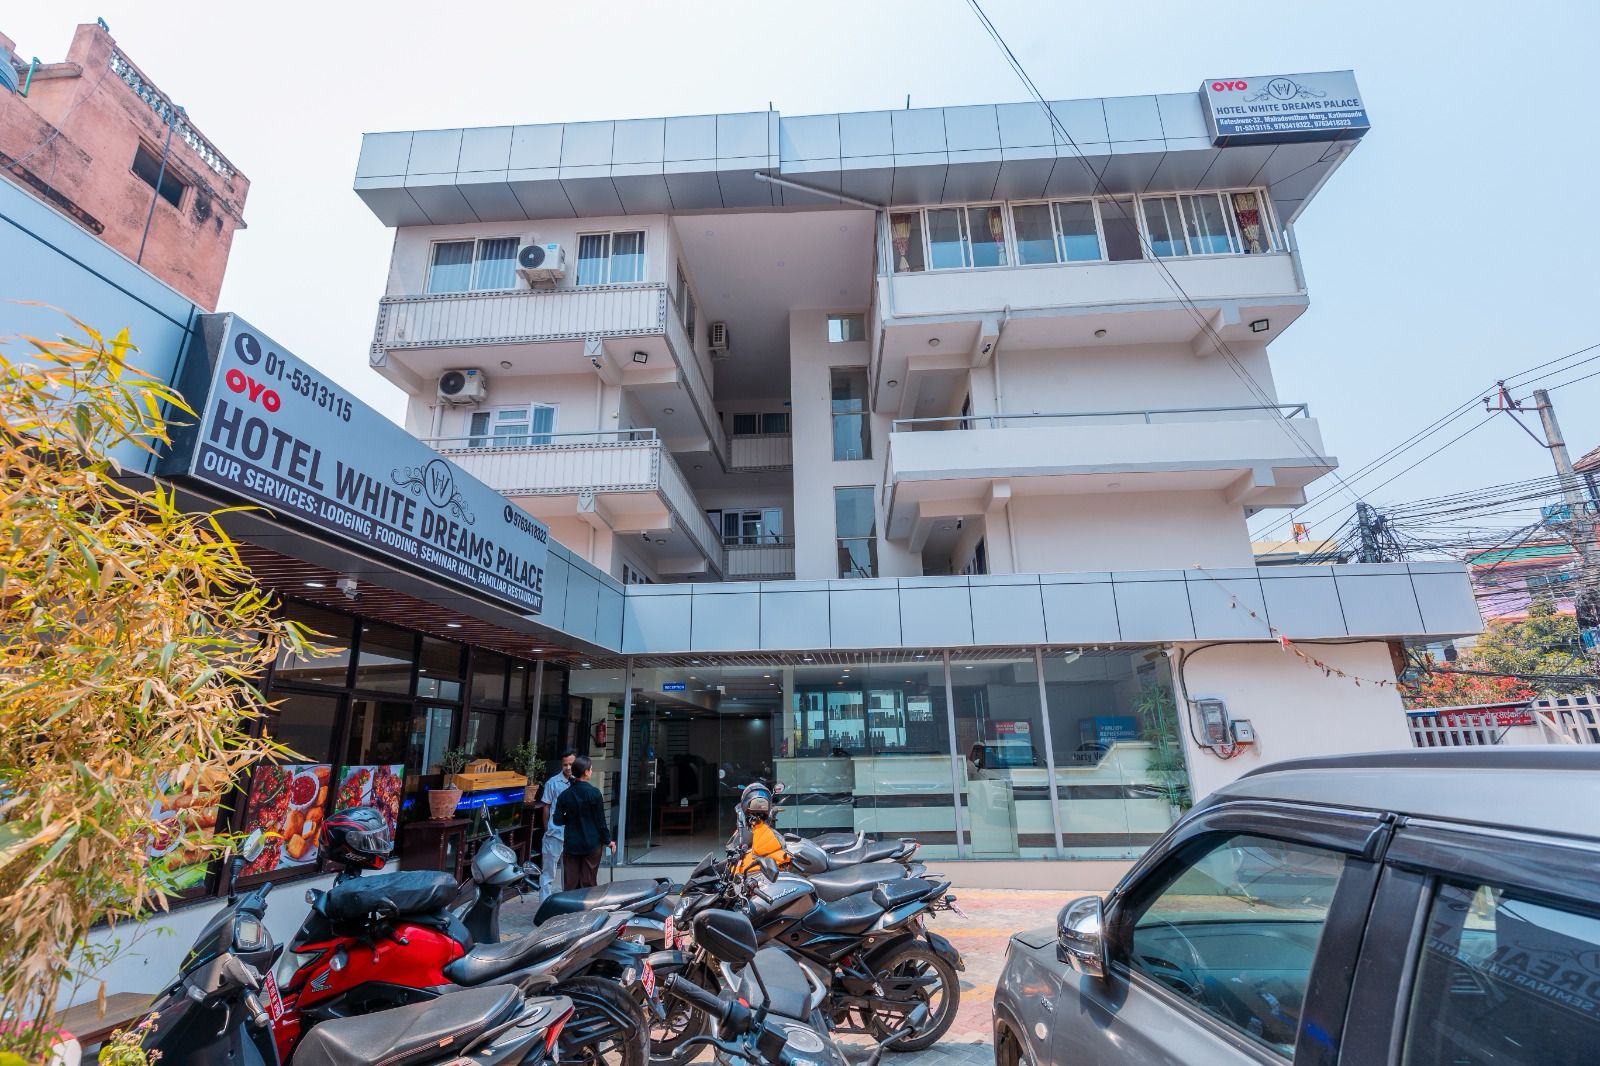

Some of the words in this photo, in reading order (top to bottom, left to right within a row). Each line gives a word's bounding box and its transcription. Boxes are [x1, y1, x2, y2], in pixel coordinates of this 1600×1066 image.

[1211, 80, 1248, 92] OYO
[1217, 106, 1247, 115] HOTEL
[1249, 104, 1279, 113] WHITE
[1282, 101, 1321, 111] DREAMS
[1324, 98, 1360, 108] PALACE
[225, 368, 281, 413] OYO
[264, 351, 353, 422] 01-5313115
[209, 398, 324, 491] HOTEL
[335, 460, 417, 533] WHITE
[420, 506, 494, 569] DREAMS
[496, 545, 544, 593] PALACE
[203, 451, 242, 483] OUR
[243, 468, 318, 515] SERVICES:
[319, 500, 372, 541] LODGING,
[374, 524, 419, 559] FOODING,
[420, 545, 457, 573] SEMINAR
[457, 562, 477, 584] HALL,
[478, 570, 507, 594] FAMILIAR
[507, 583, 541, 608] RESTAURANT
[513, 511, 547, 545] 9763418322
